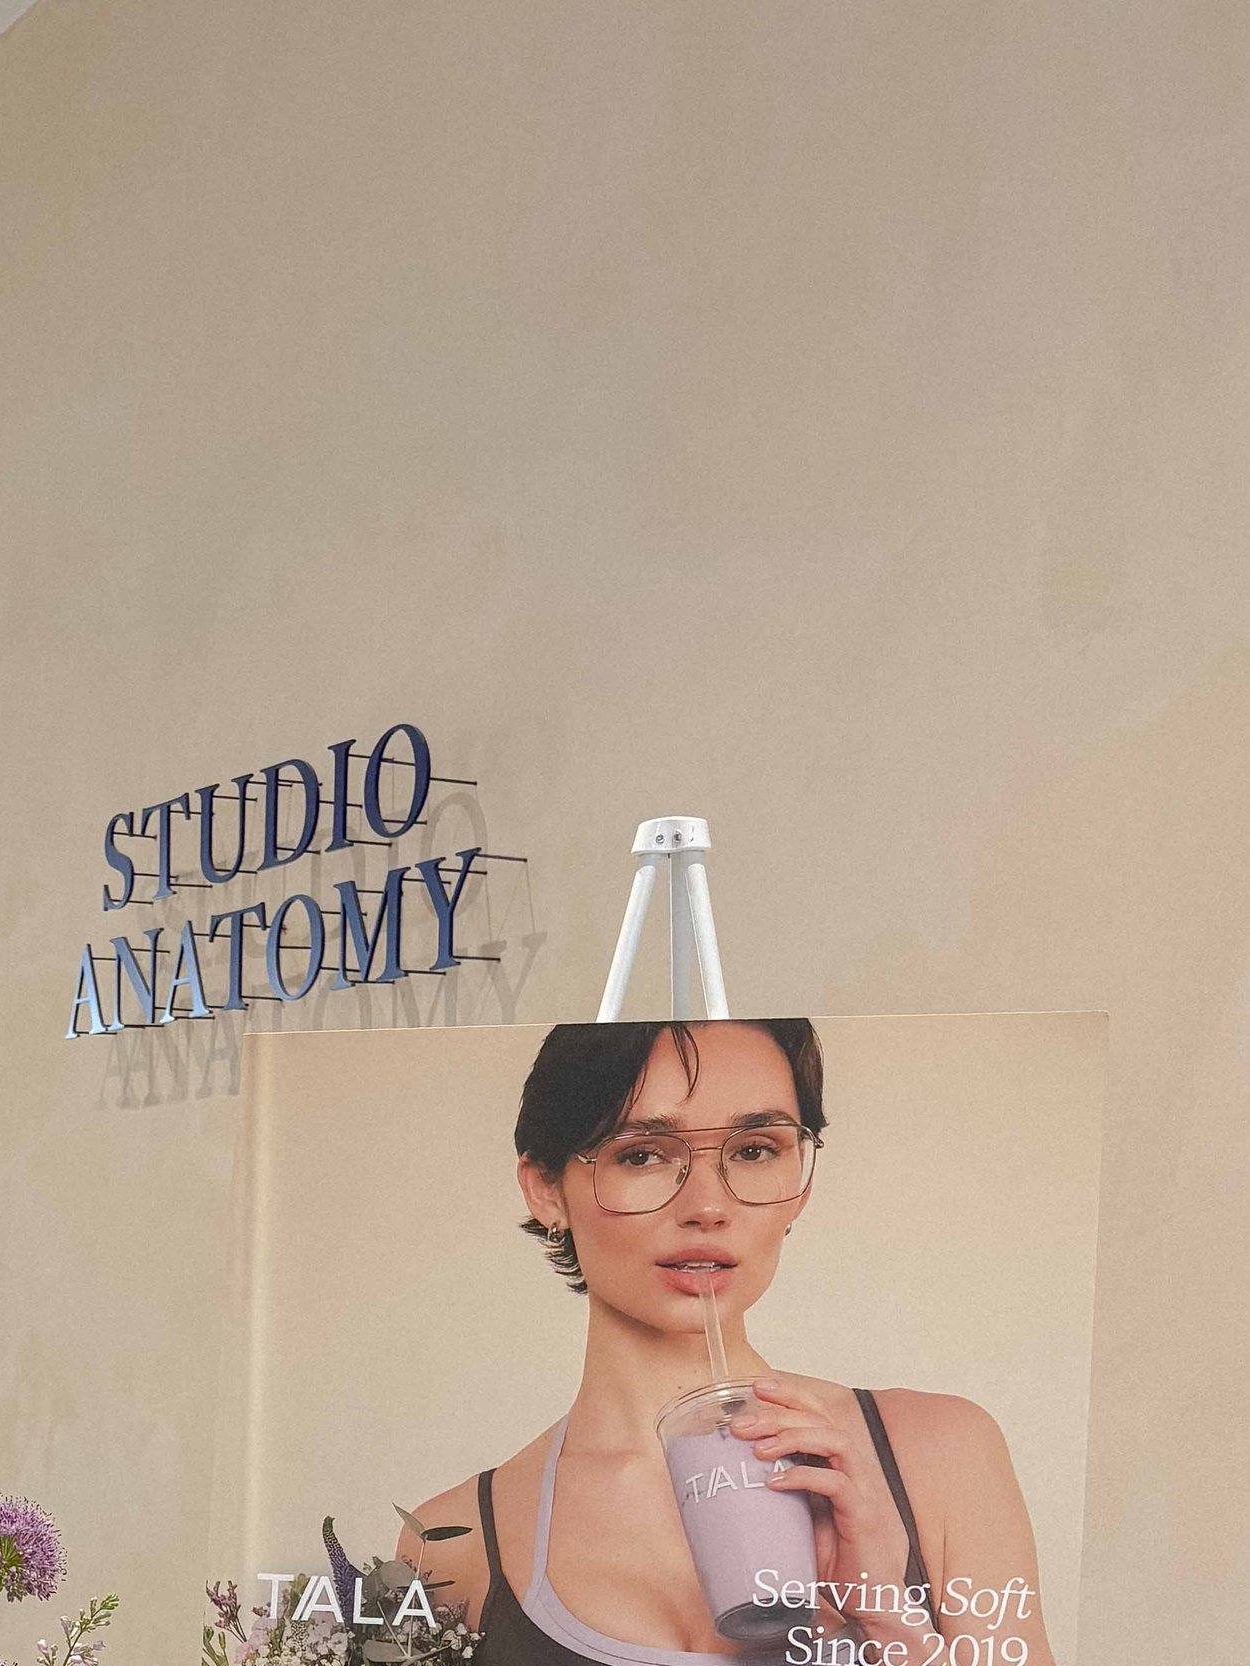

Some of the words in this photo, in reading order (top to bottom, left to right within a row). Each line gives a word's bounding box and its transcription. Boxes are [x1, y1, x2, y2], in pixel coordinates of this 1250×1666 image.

[103, 723, 432, 911] STUDIO
[65, 847, 482, 1040] ANATOMY
[257, 1573, 437, 1628] TALA
[752, 1569, 931, 1627] Serving
[940, 1577, 1036, 1630] Soft
